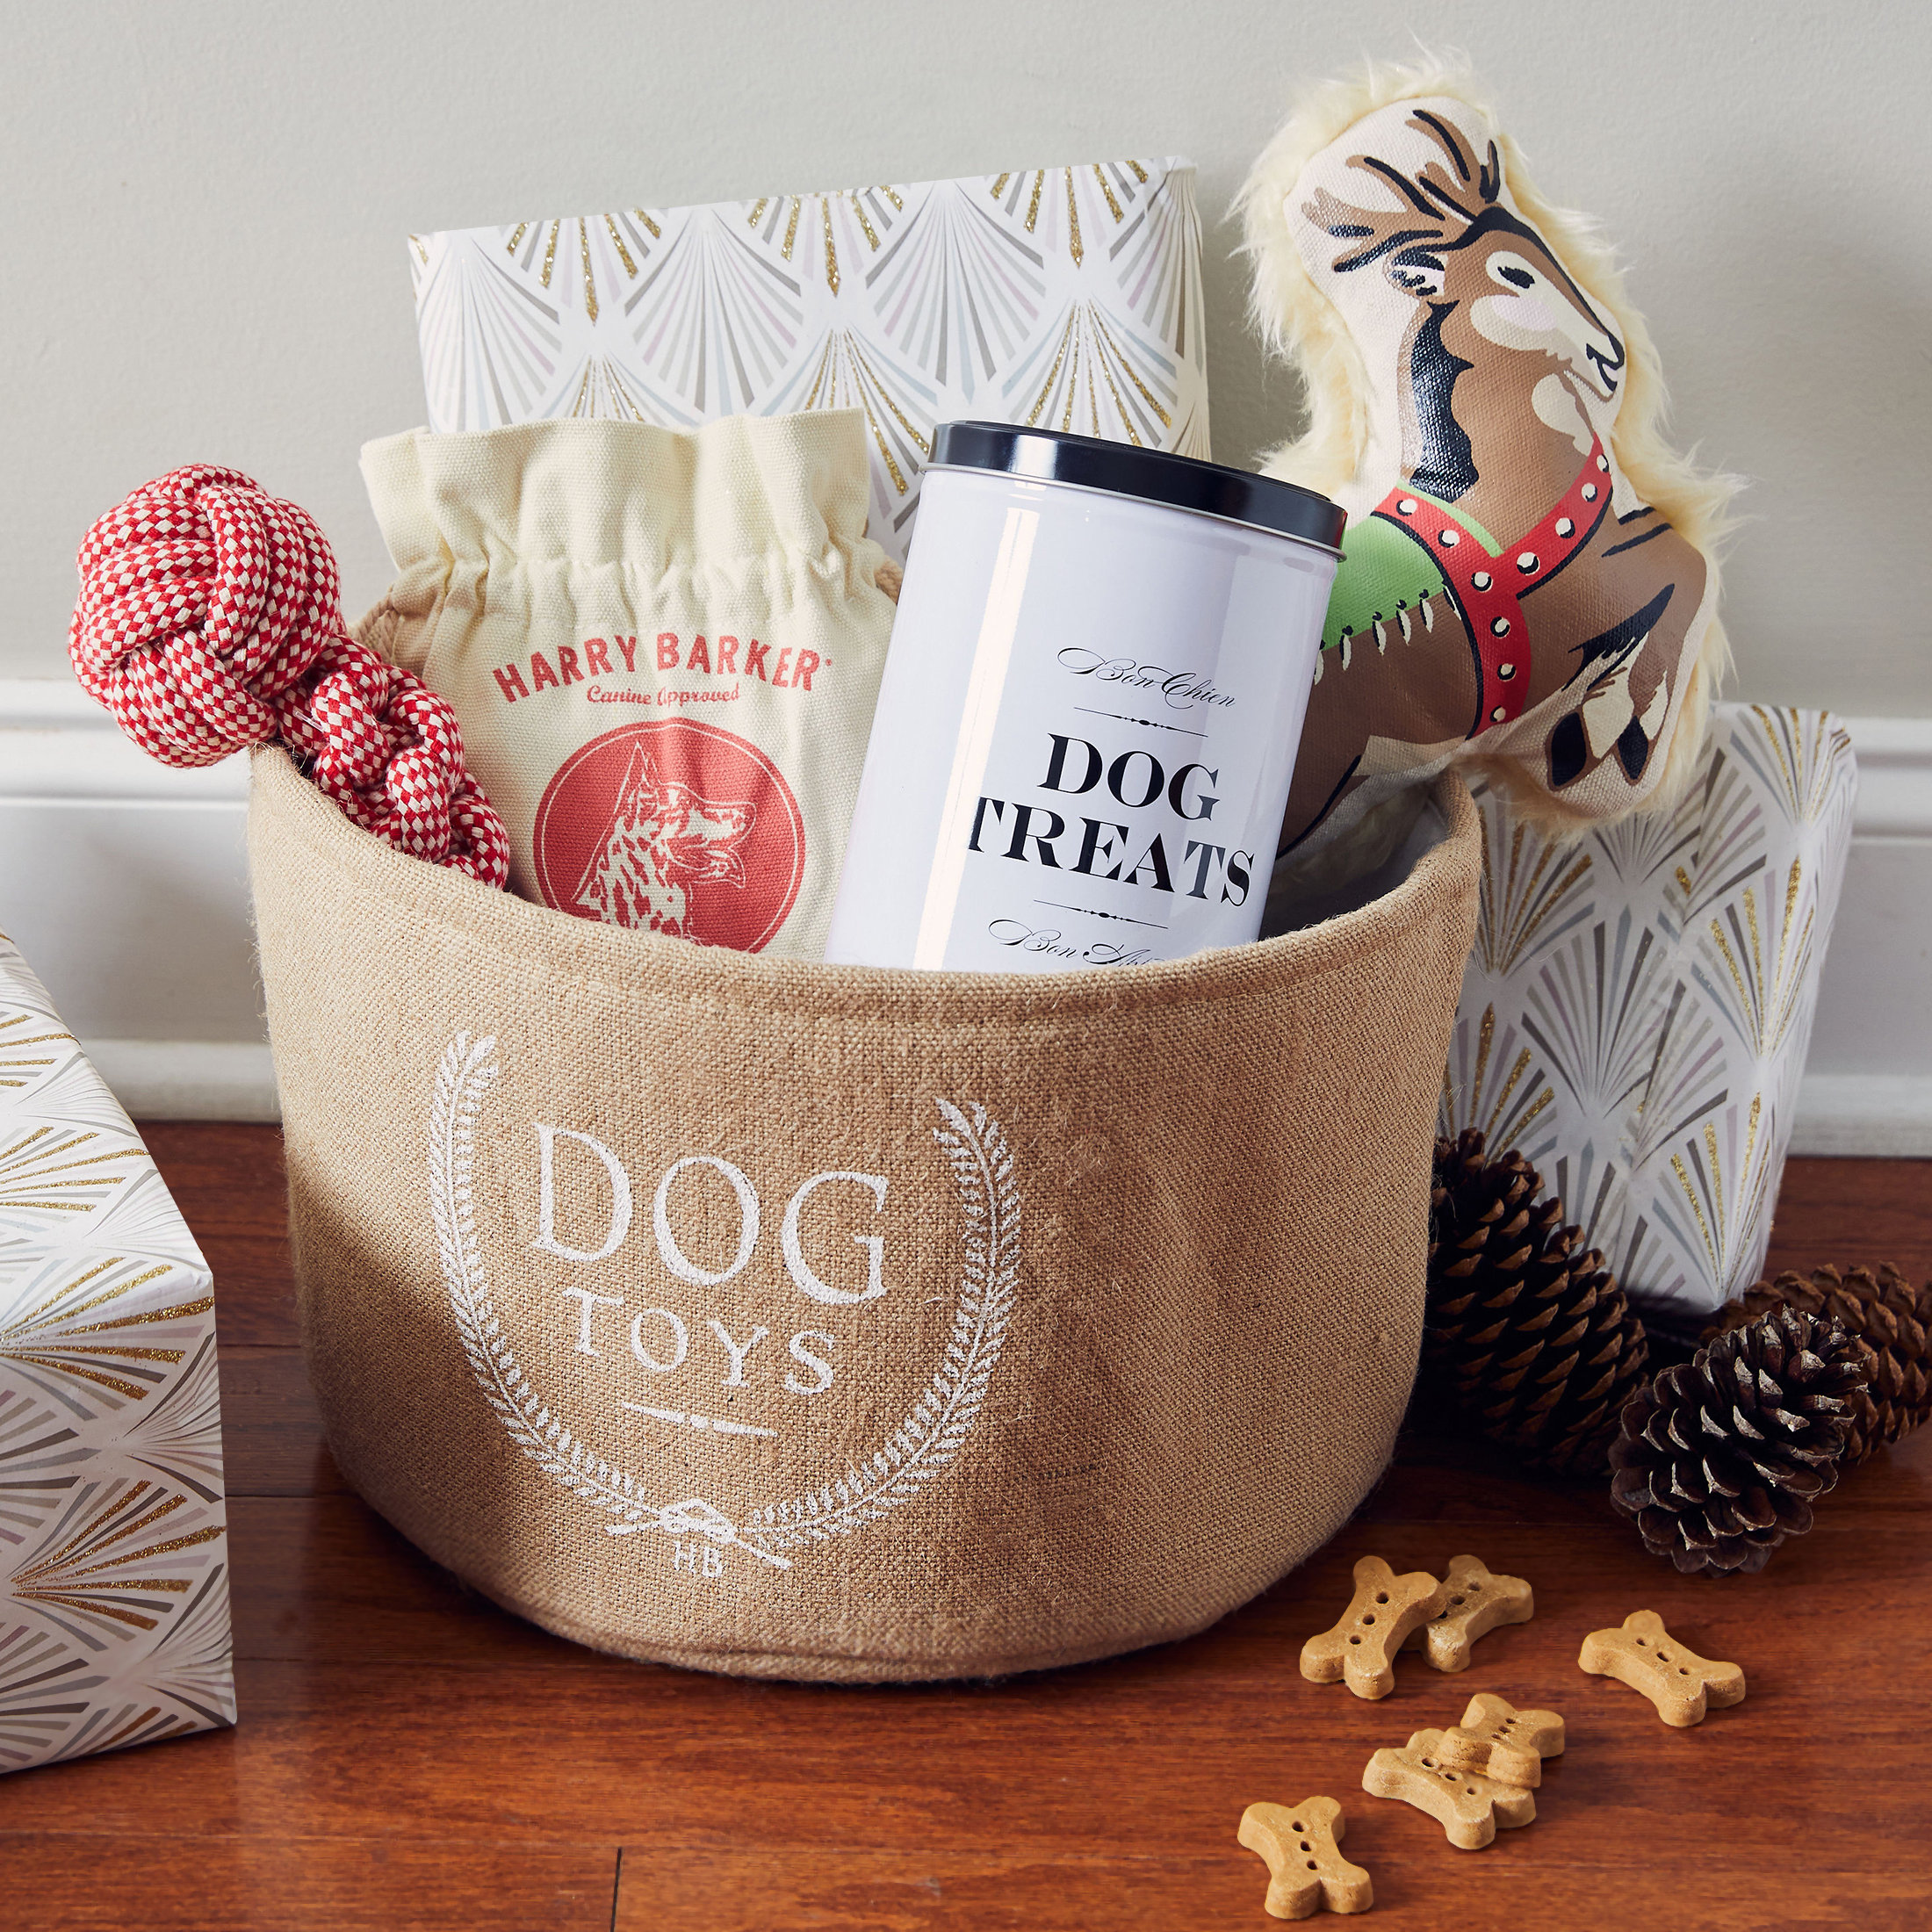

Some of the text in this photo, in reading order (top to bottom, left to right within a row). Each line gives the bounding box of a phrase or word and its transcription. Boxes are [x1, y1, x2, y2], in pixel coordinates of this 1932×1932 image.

[491, 631, 822, 703] HARRY BARKER
[586, 681, 739, 708] Canine Approved
[1056, 647, 1236, 710] Bon Chien
[1036, 732, 1221, 822] DOG
[967, 796, 1256, 907] TREATS
[987, 919, 1078, 959] Bon
[529, 1121, 889, 1305] DOG
[561, 1286, 837, 1395] TOYS
[672, 1539, 724, 1579] HB
